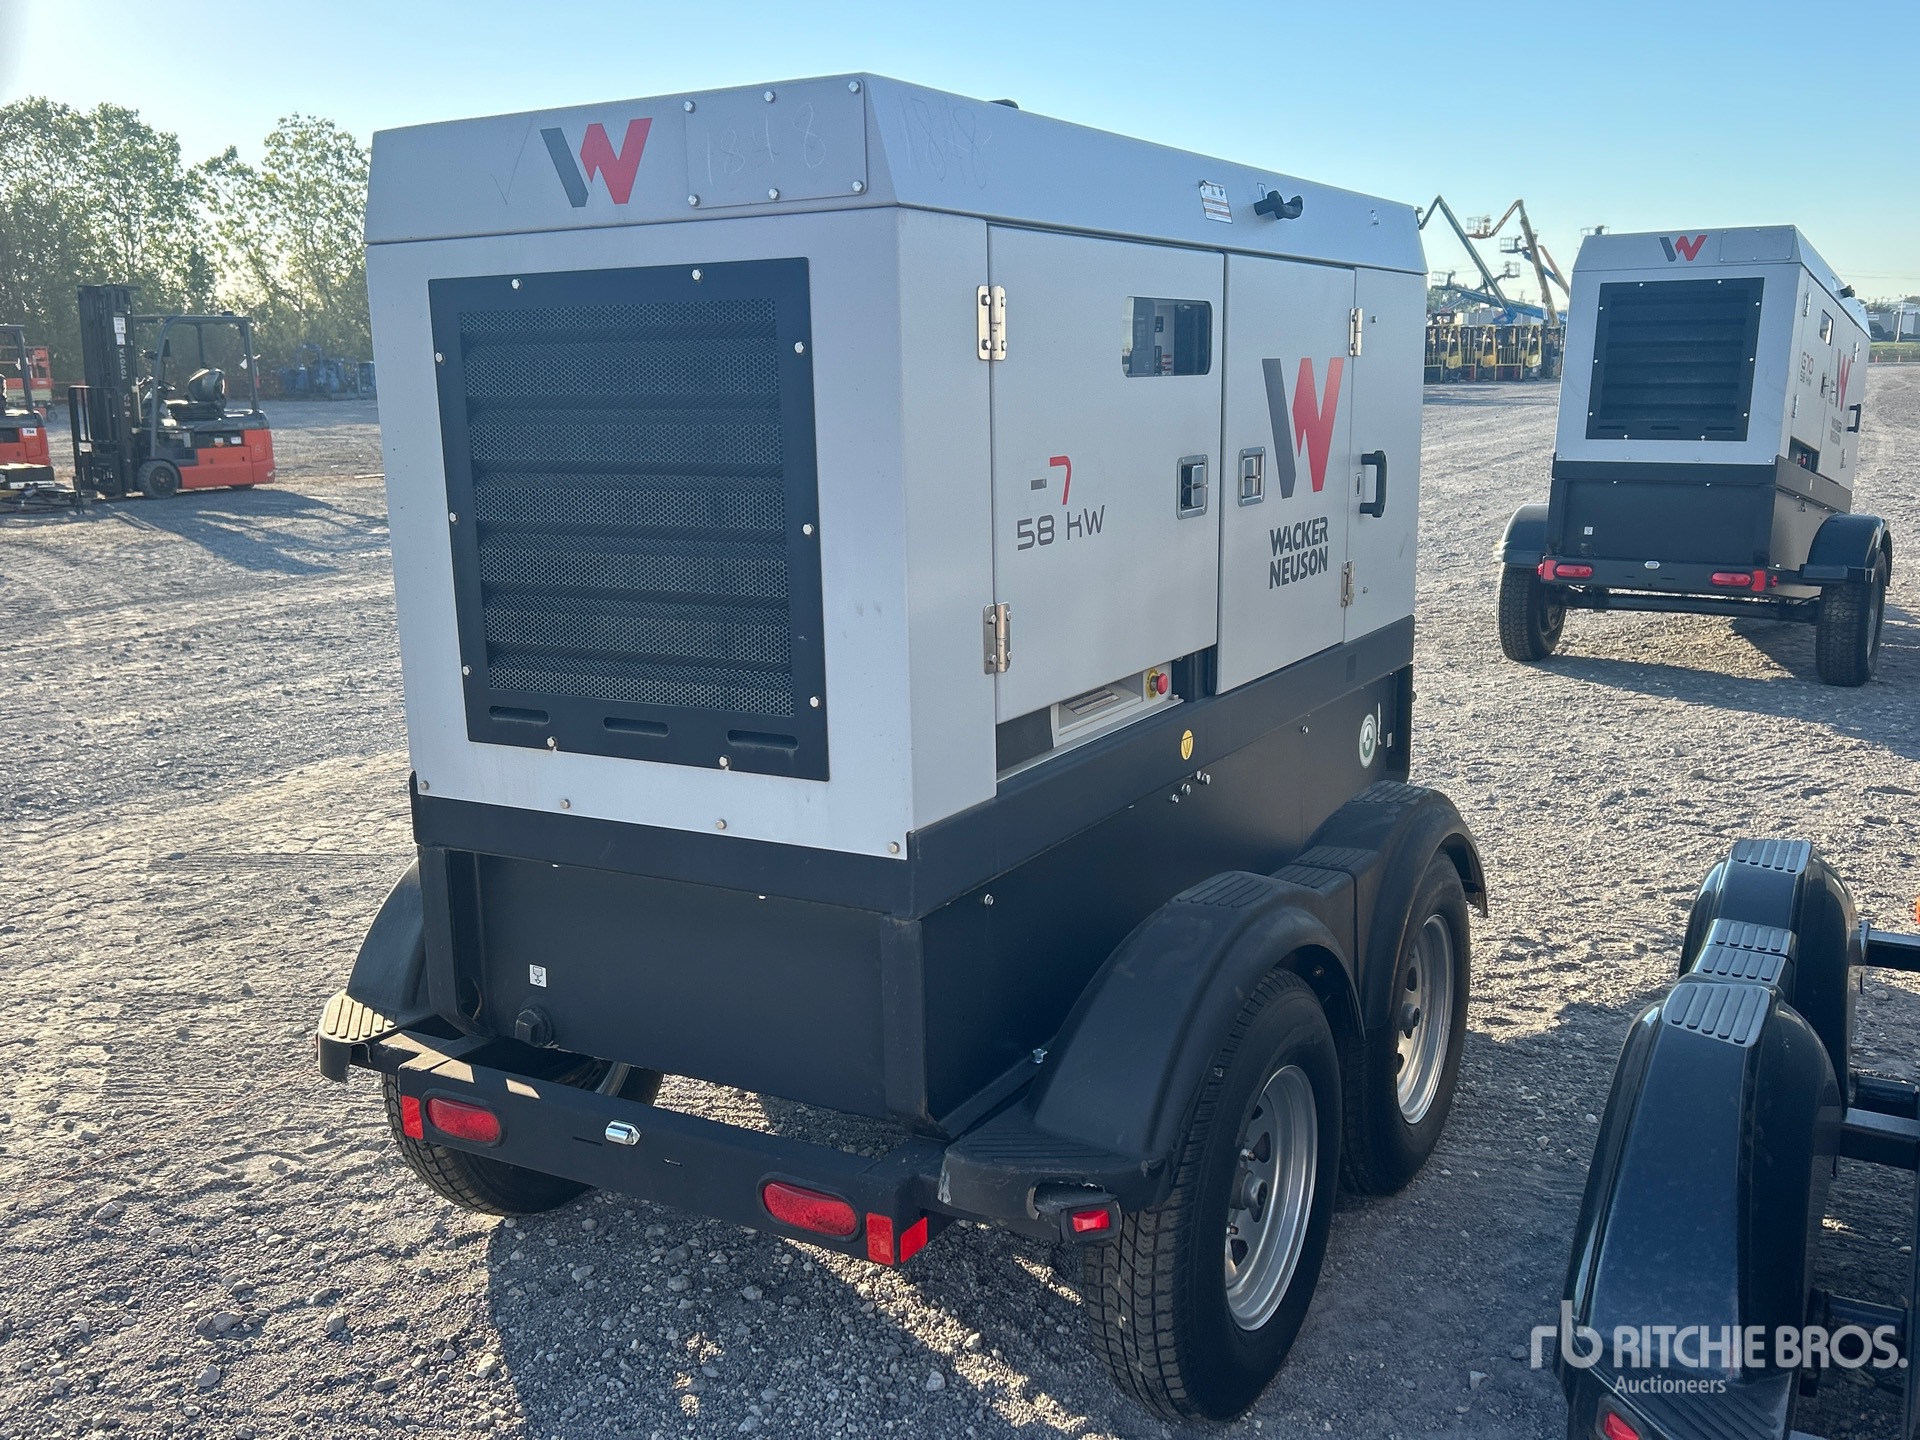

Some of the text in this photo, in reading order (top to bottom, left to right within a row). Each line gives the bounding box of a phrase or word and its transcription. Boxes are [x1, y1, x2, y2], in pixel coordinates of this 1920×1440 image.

[119, 348, 127, 380] TOYOTA
[1017, 504, 1105, 551] 58 kW
[1269, 516, 1328, 557] WACKER
[1269, 545, 1328, 589] NEUSON
